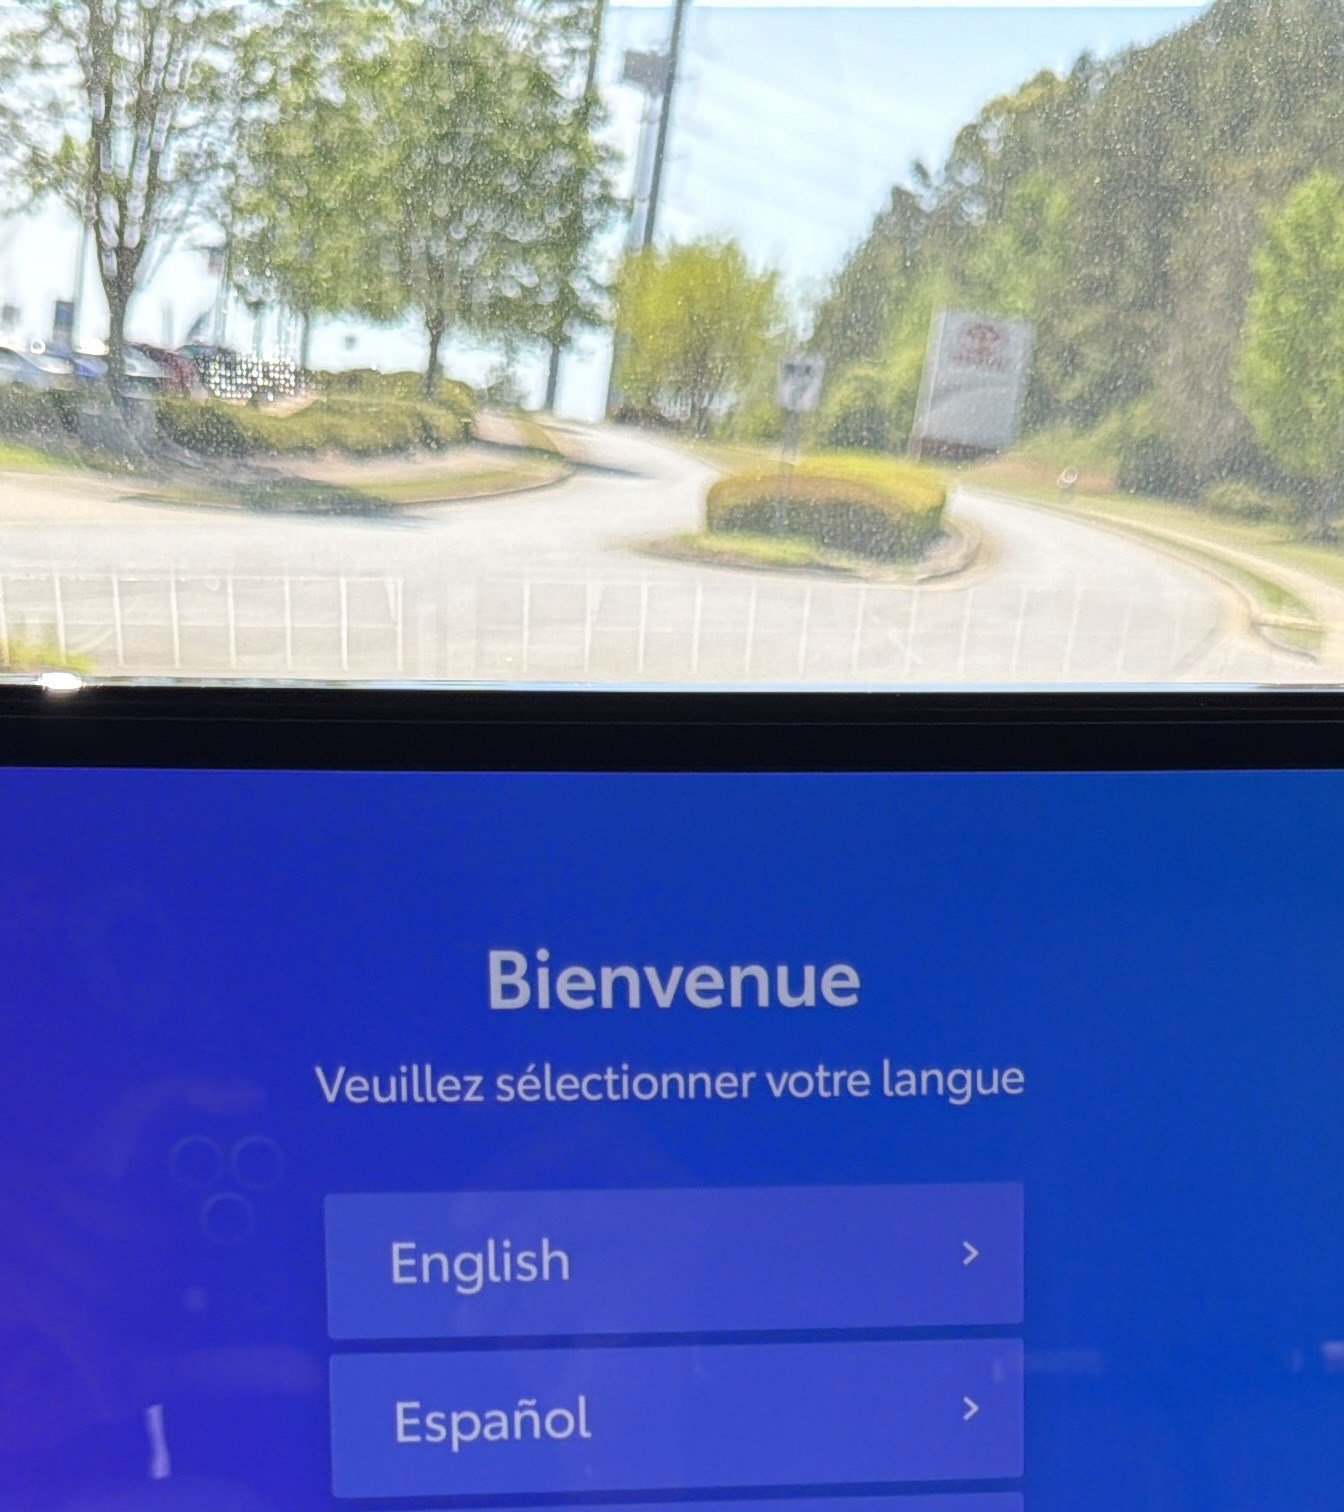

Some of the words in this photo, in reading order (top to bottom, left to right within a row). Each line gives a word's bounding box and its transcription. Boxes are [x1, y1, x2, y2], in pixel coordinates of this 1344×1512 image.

[486, 948, 861, 1010] Bienvenue
[314, 1065, 484, 1105] Veuillez
[495, 1062, 757, 1102] sélectionner
[764, 1064, 871, 1100] votre
[881, 1059, 1026, 1106] langue
[390, 1238, 571, 1296] English
[394, 1395, 592, 1453] Español
